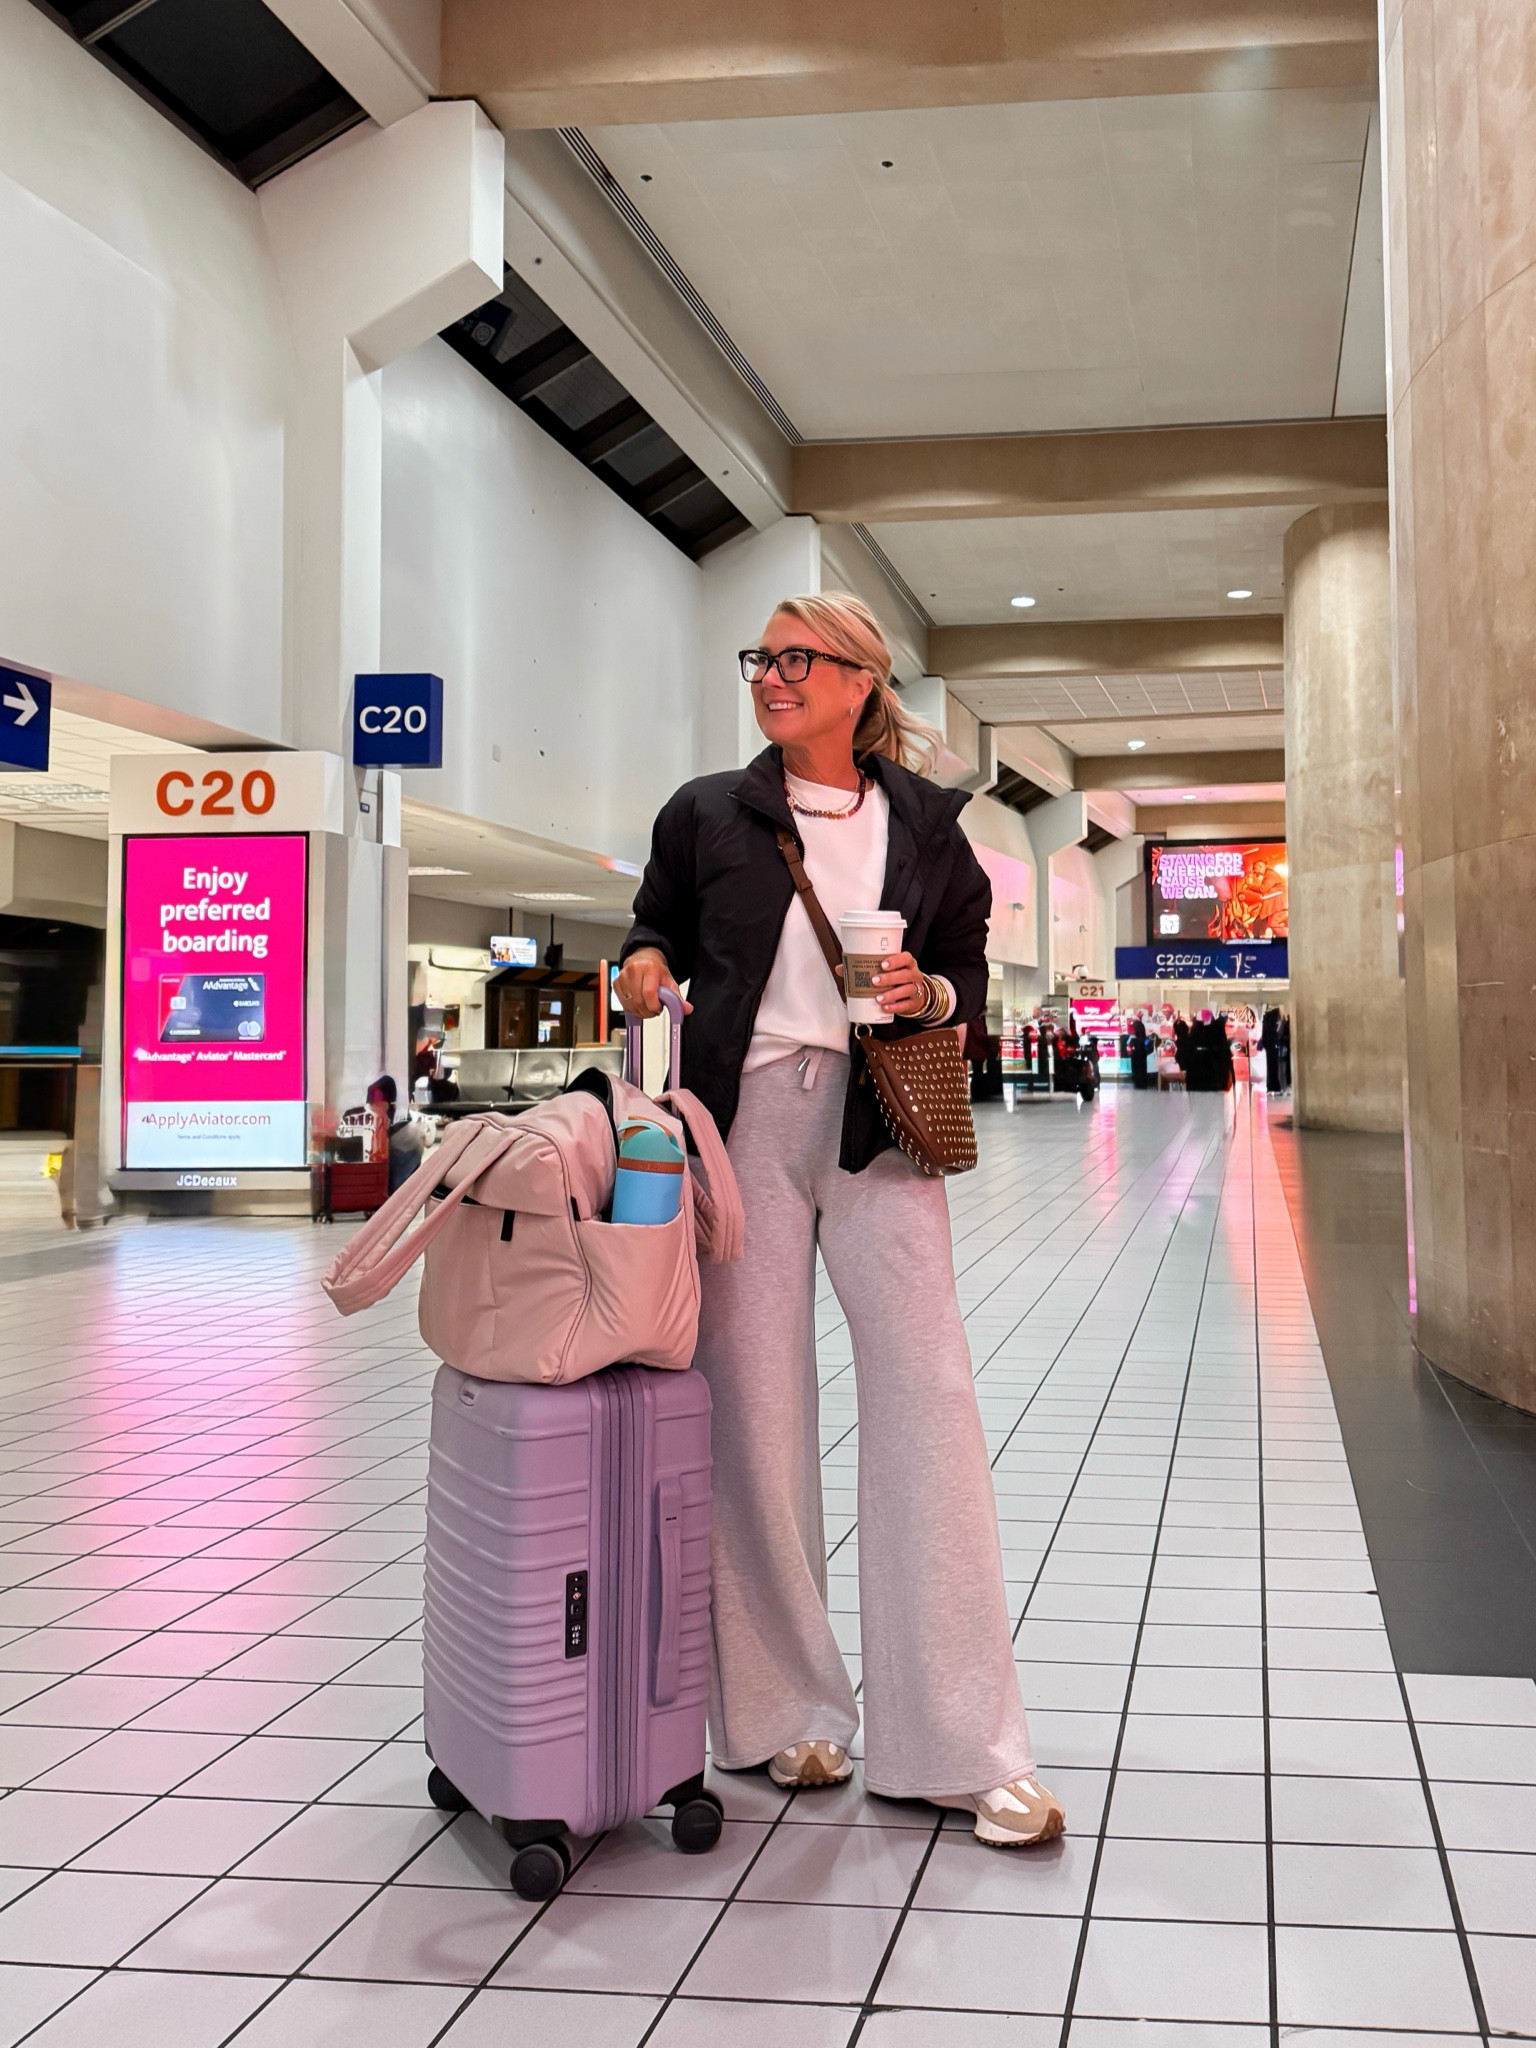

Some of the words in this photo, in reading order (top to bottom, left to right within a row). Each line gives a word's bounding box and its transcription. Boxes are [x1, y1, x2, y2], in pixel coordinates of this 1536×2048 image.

[358, 705, 427, 734] C20
[156, 770, 276, 817] C20
[183, 866, 248, 895] Enjoy
[1161, 886, 1184, 899] WE
[160, 897, 270, 928] preferred
[163, 929, 269, 958] boarding
[1080, 986, 1104, 997] C21
[176, 1174, 238, 1187] JCDecaux
